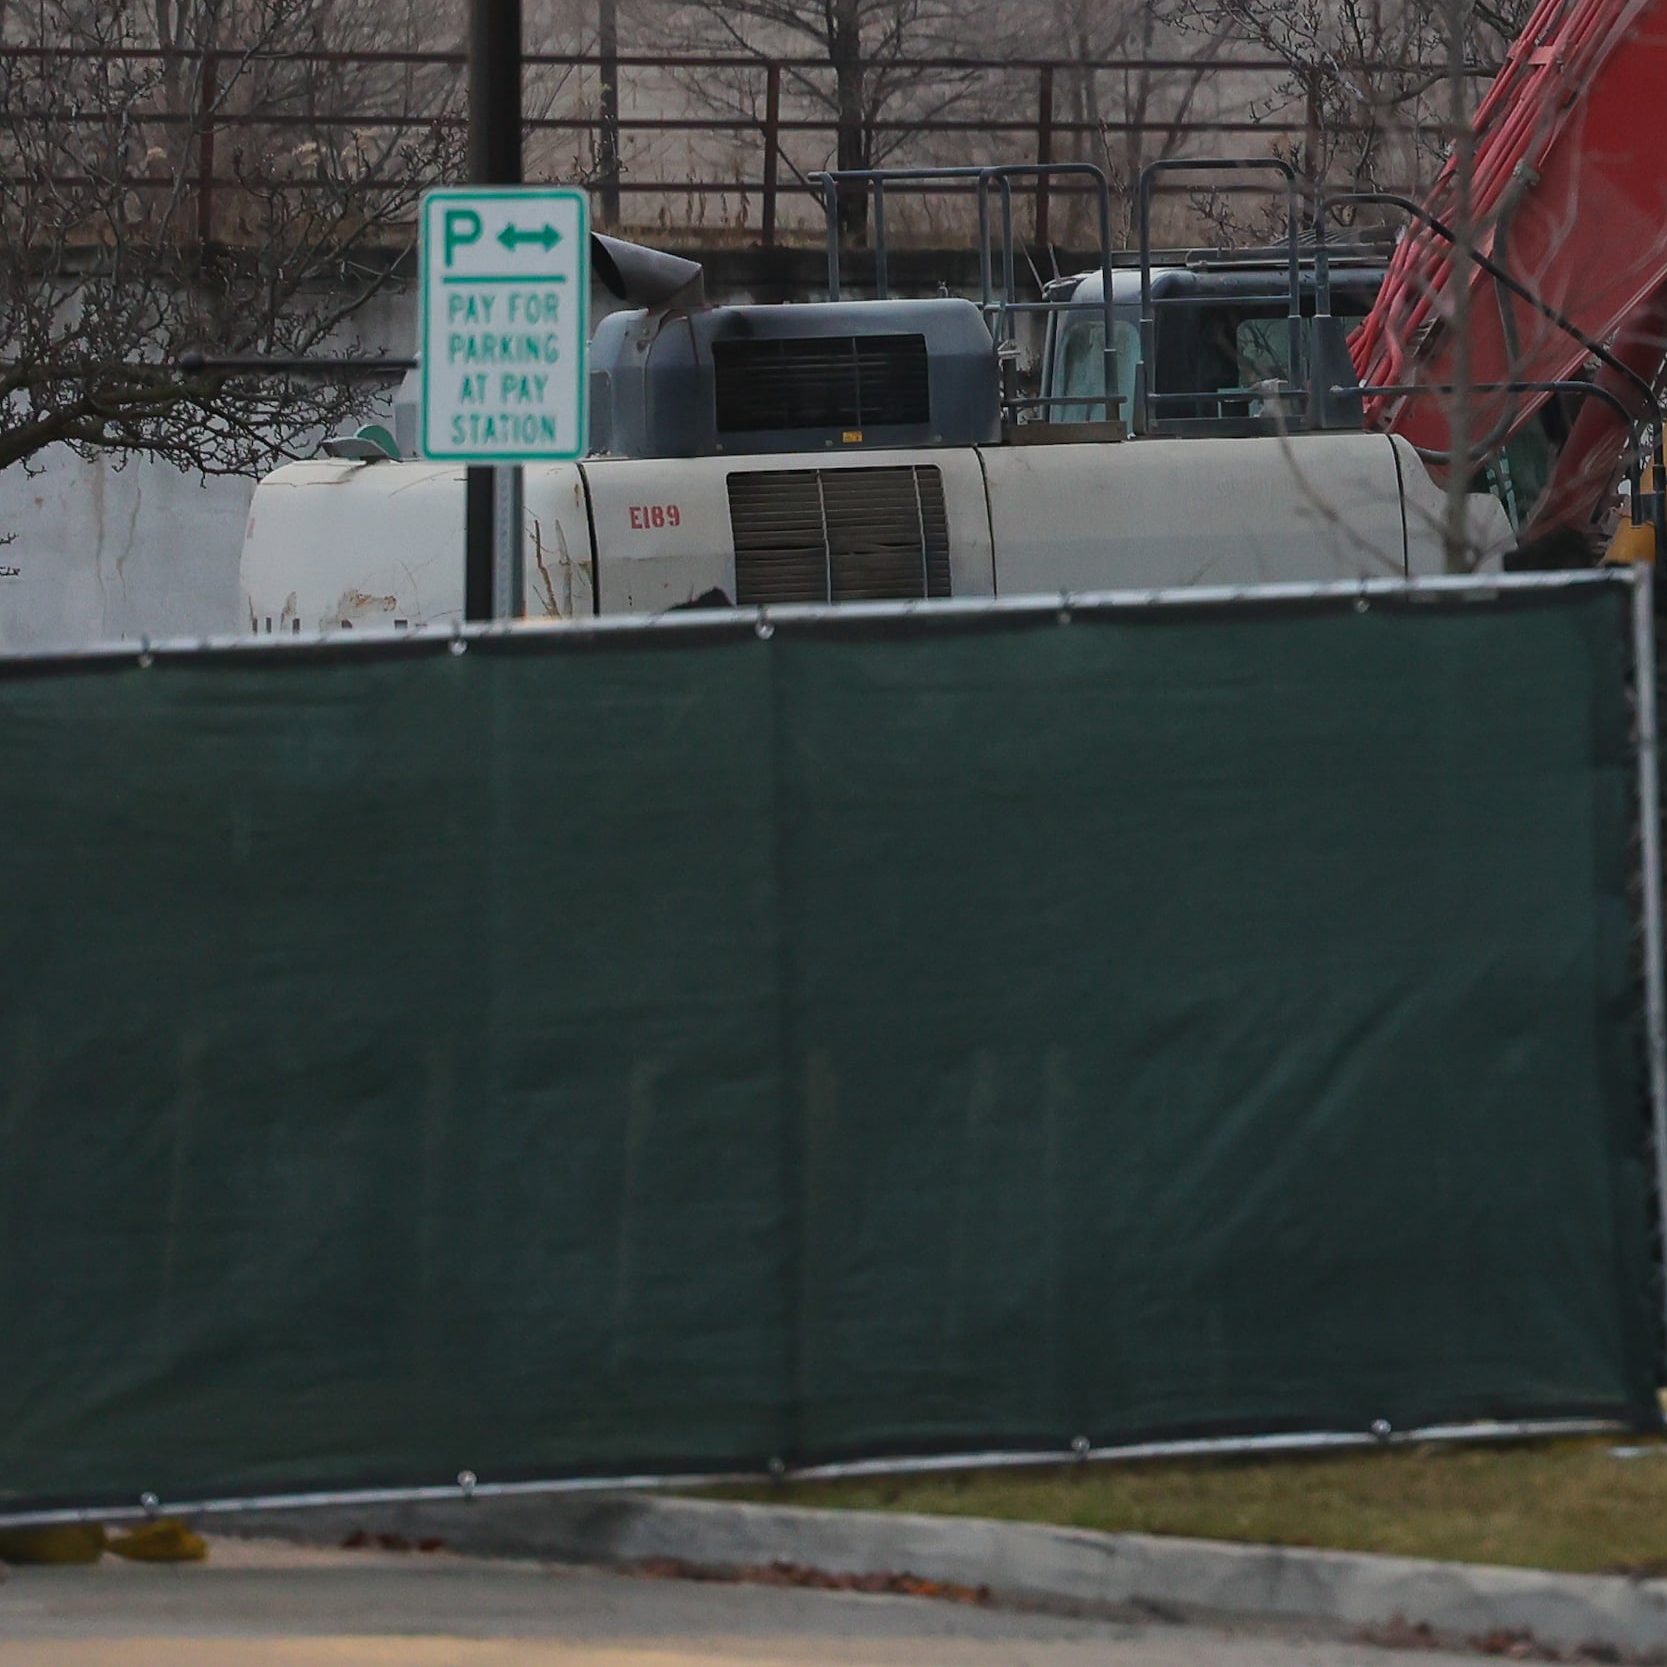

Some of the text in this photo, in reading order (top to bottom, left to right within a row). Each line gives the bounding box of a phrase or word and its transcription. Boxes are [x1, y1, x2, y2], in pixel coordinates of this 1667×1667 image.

[444, 209, 483, 268] P
[448, 293, 560, 325] PAY FOR
[448, 332, 560, 365] PARKING
[461, 373, 550, 404] AT PAY
[451, 414, 557, 445] STATION
